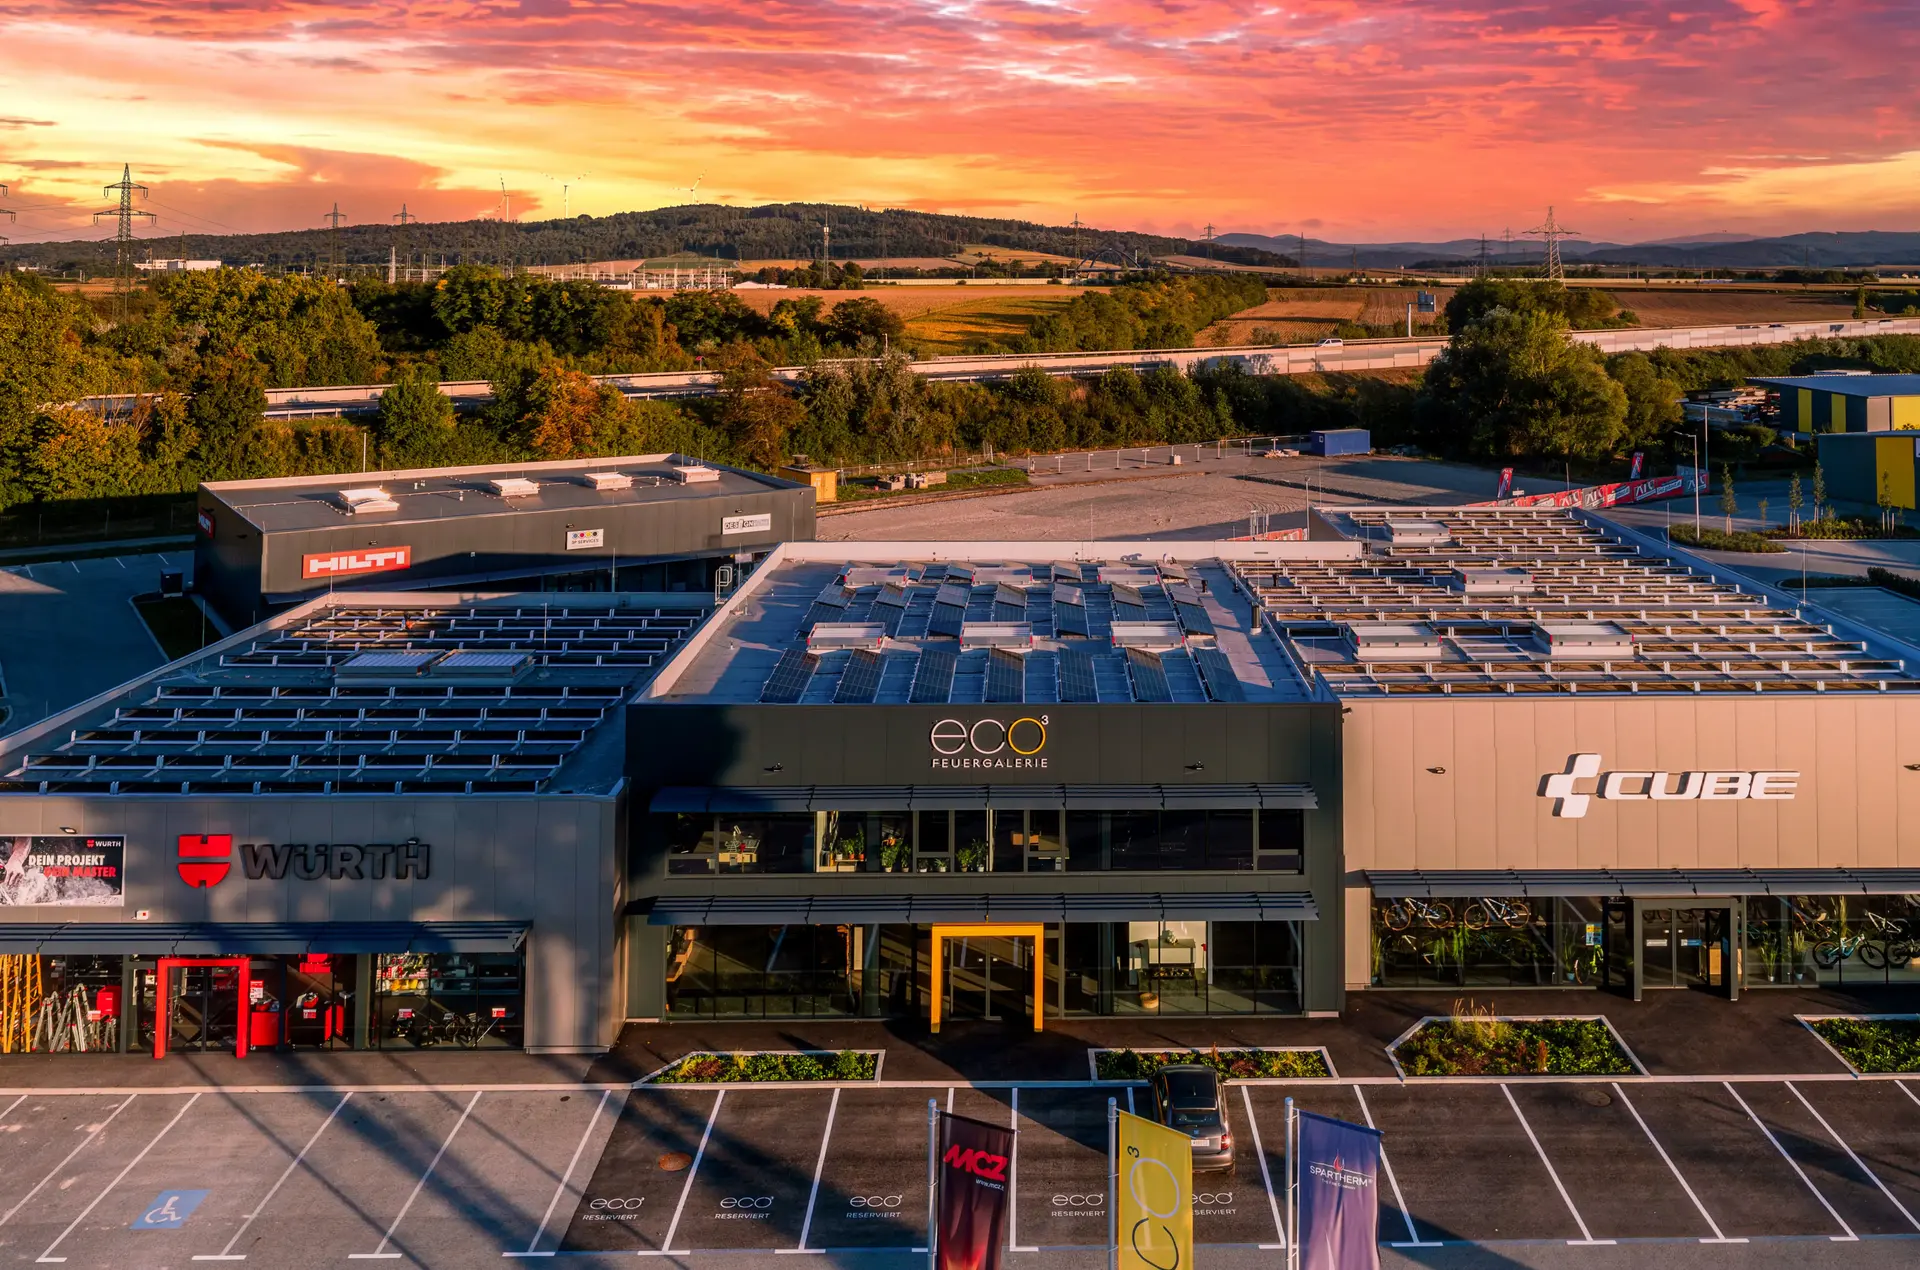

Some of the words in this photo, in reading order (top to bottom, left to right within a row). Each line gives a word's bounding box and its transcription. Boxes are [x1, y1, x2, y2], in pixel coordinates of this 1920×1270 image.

[309, 551, 405, 573] HILTI
[932, 758, 1048, 768] FEUERGALERIE
[1602, 770, 1800, 800] CUBE
[28, 854, 55, 866] DEIN
[57, 854, 105, 866] PROJEKT
[72, 866, 117, 878] MASTER
[943, 1144, 1008, 1182] MCZ
[1191, 1208, 1237, 1216] SERVIERT
